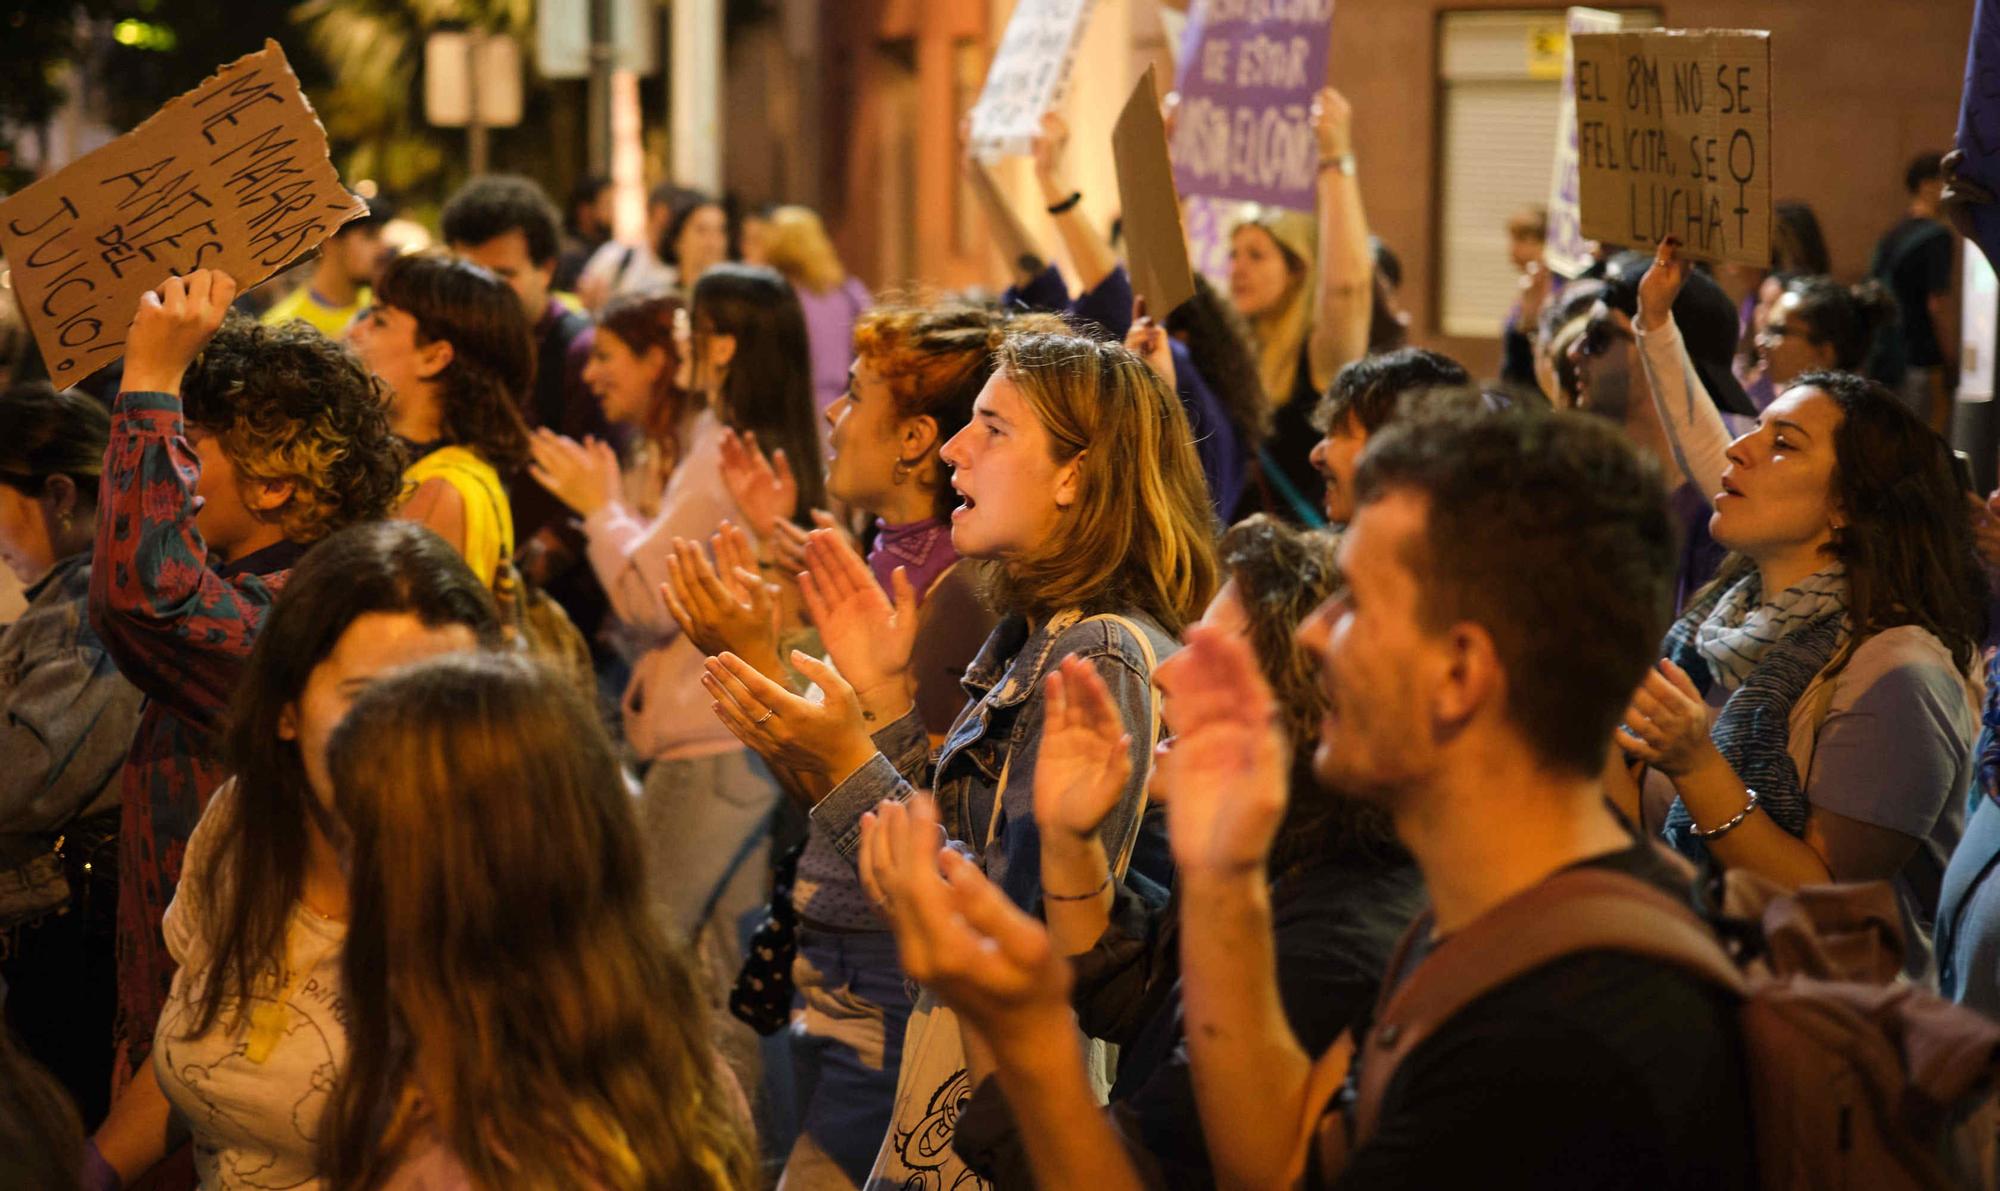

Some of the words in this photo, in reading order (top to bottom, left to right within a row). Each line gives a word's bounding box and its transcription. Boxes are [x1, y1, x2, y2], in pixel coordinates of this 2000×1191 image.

[191, 69, 286, 146] ME
[1578, 60, 1607, 103] EL
[1627, 55, 1663, 119] 8M
[1673, 61, 1703, 116] NO
[1717, 64, 1750, 114] SE
[1690, 135, 1717, 182] SE
[100, 155, 224, 278] ANTES
[1630, 182, 1726, 255] LUCHA
[95, 224, 138, 279] DEL
